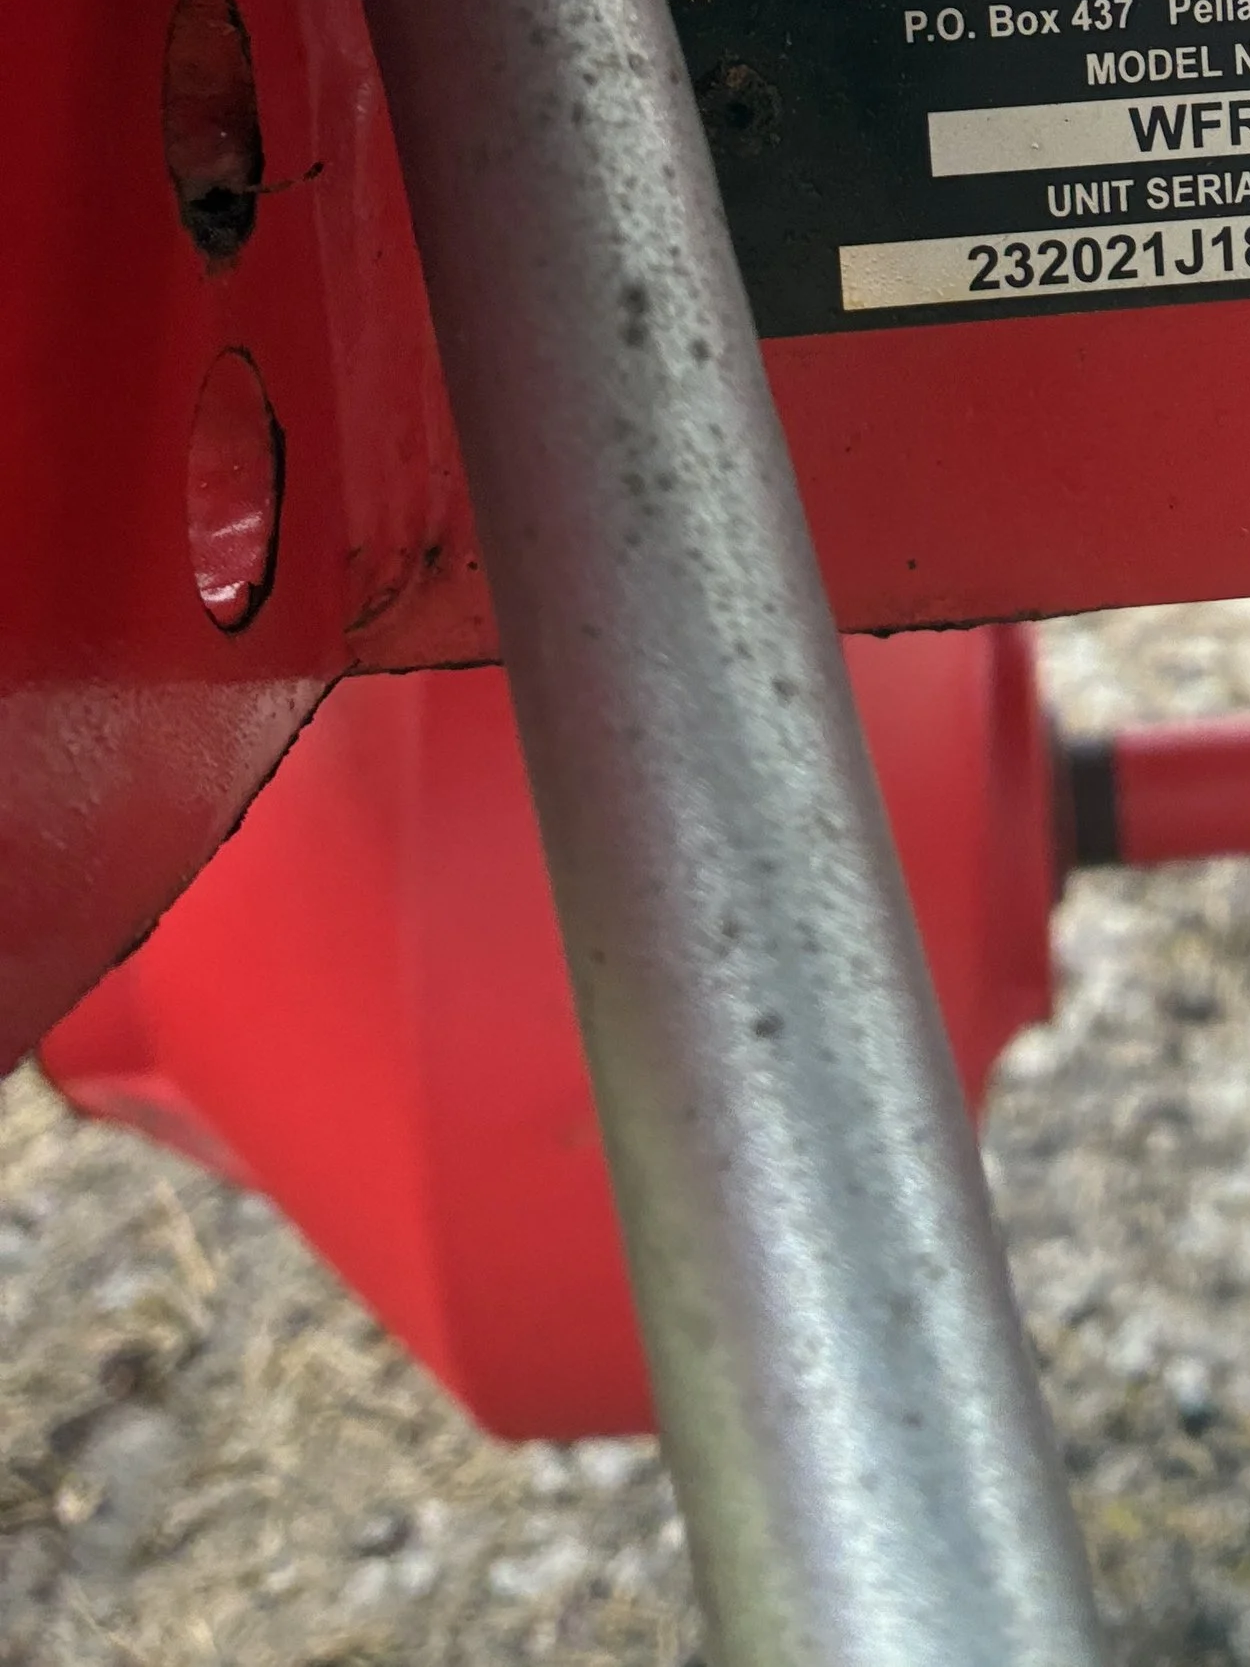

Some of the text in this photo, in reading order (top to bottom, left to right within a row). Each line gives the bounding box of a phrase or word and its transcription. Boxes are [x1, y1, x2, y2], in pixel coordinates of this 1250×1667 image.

[903, 7, 976, 43] P.O.
[988, 2, 1059, 37] Box
[1086, 46, 1222, 86] MODEL
[1047, 179, 1135, 218] UNIT
